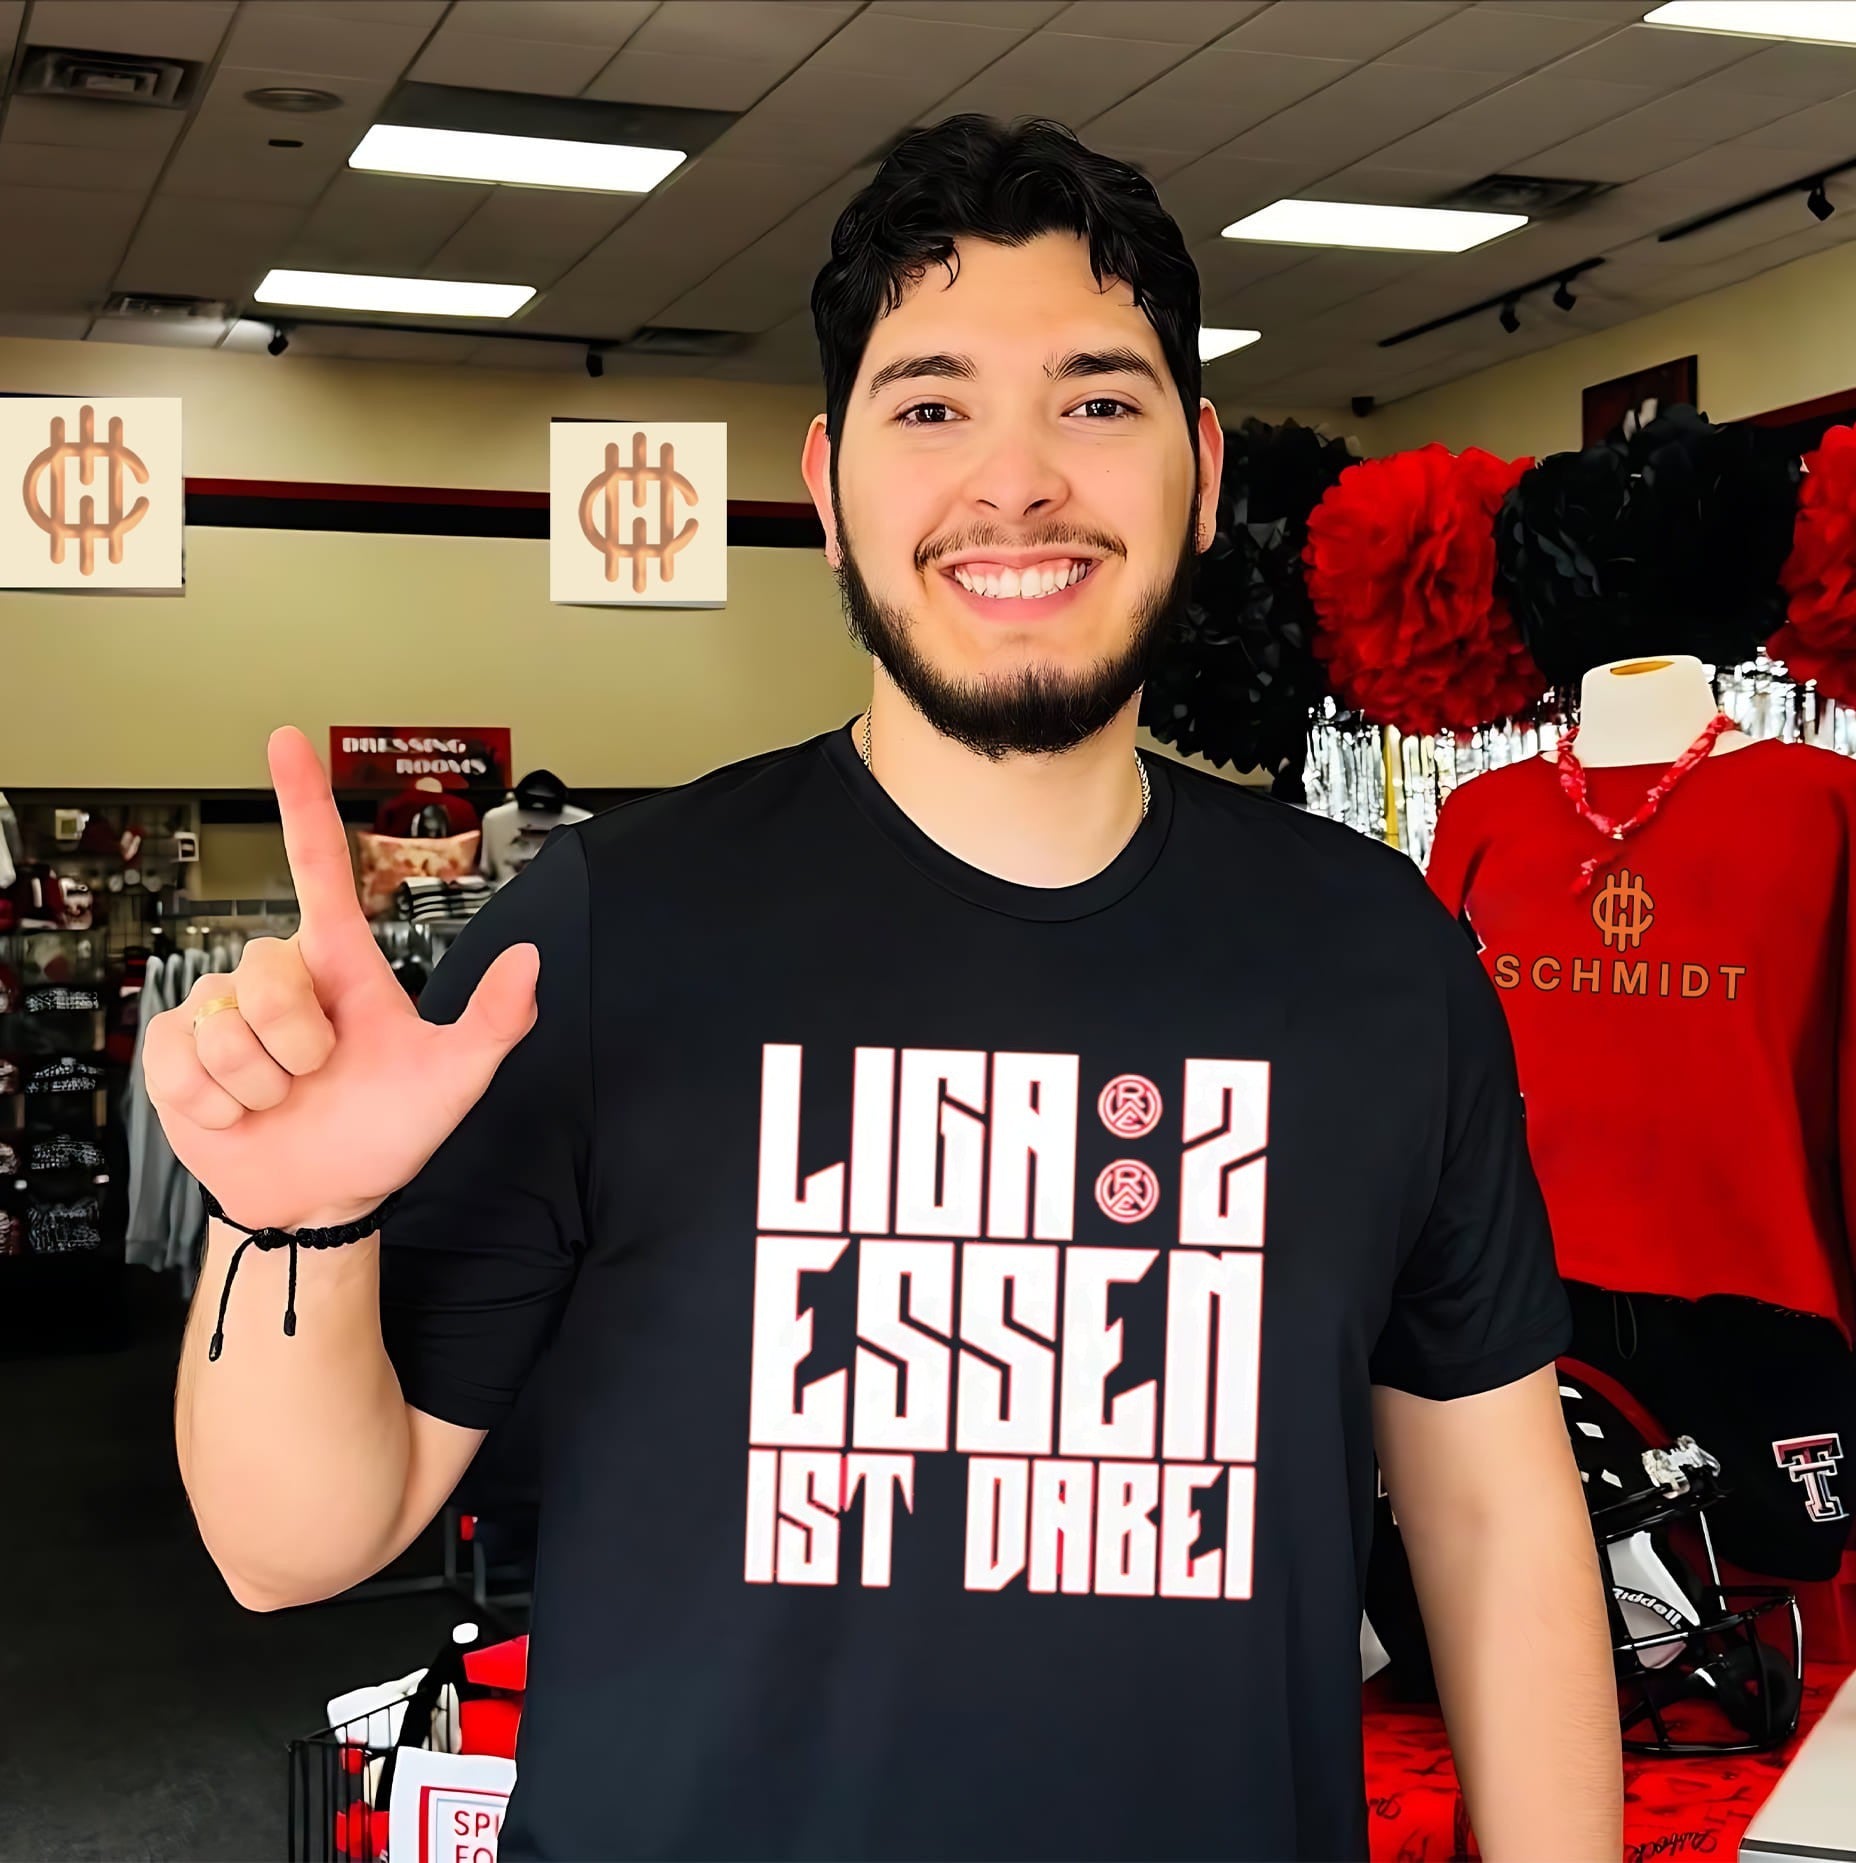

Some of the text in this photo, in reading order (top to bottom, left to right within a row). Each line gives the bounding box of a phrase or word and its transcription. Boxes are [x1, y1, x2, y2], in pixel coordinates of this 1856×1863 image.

[342, 737, 467, 753] DRESSING
[396, 758, 487, 775] ROOMS
[1494, 953, 1747, 1000] SCHMIDT
[757, 1043, 1270, 1248] LIGA 2
[749, 1236, 1264, 1463] ESSEN
[744, 1448, 1256, 1601] IST DABEI
